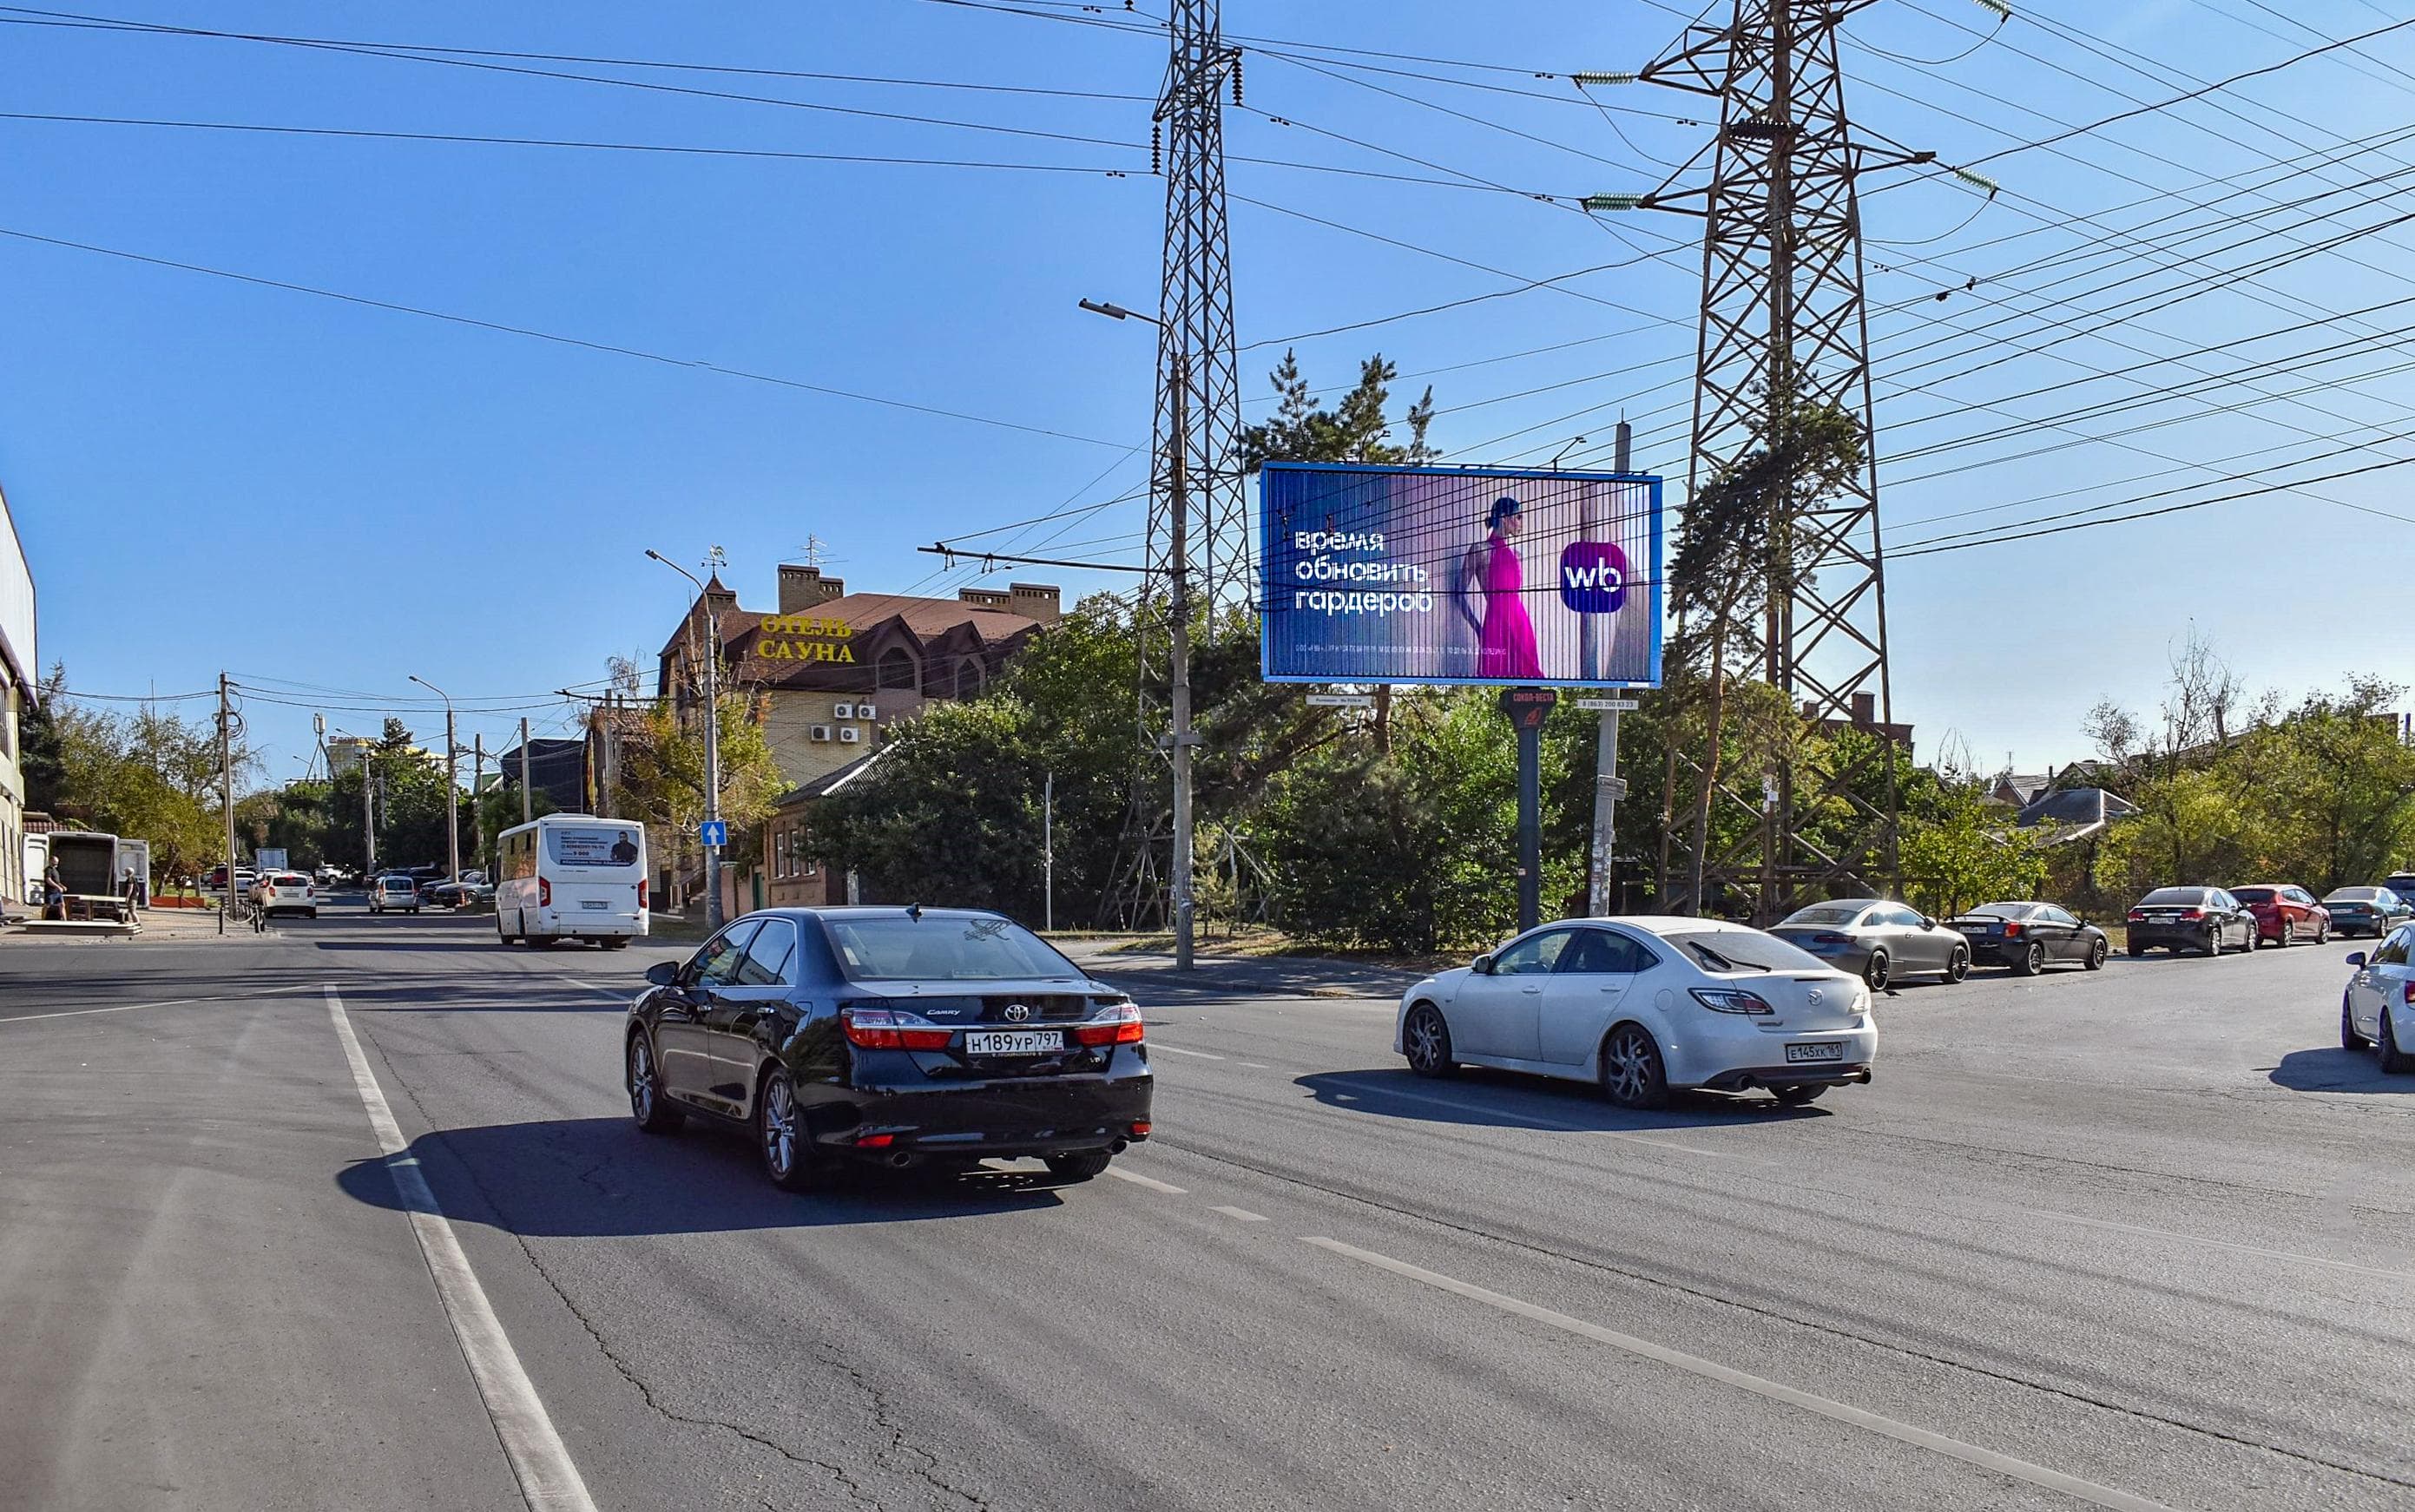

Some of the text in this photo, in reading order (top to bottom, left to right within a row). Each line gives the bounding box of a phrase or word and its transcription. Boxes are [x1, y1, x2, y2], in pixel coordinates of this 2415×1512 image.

[1295, 530, 1384, 556] время
[1295, 555, 1429, 582] обновить
[1564, 556, 1622, 593] wb
[1295, 587, 1433, 617] гардероб
[760, 615, 852, 638] ОТЕЛЬ
[757, 639, 856, 663] САУНА
[1513, 693, 1555, 702] СОКОЛ-ВЕСТА
[971, 1032, 1059, 1052] Н189УР 797
